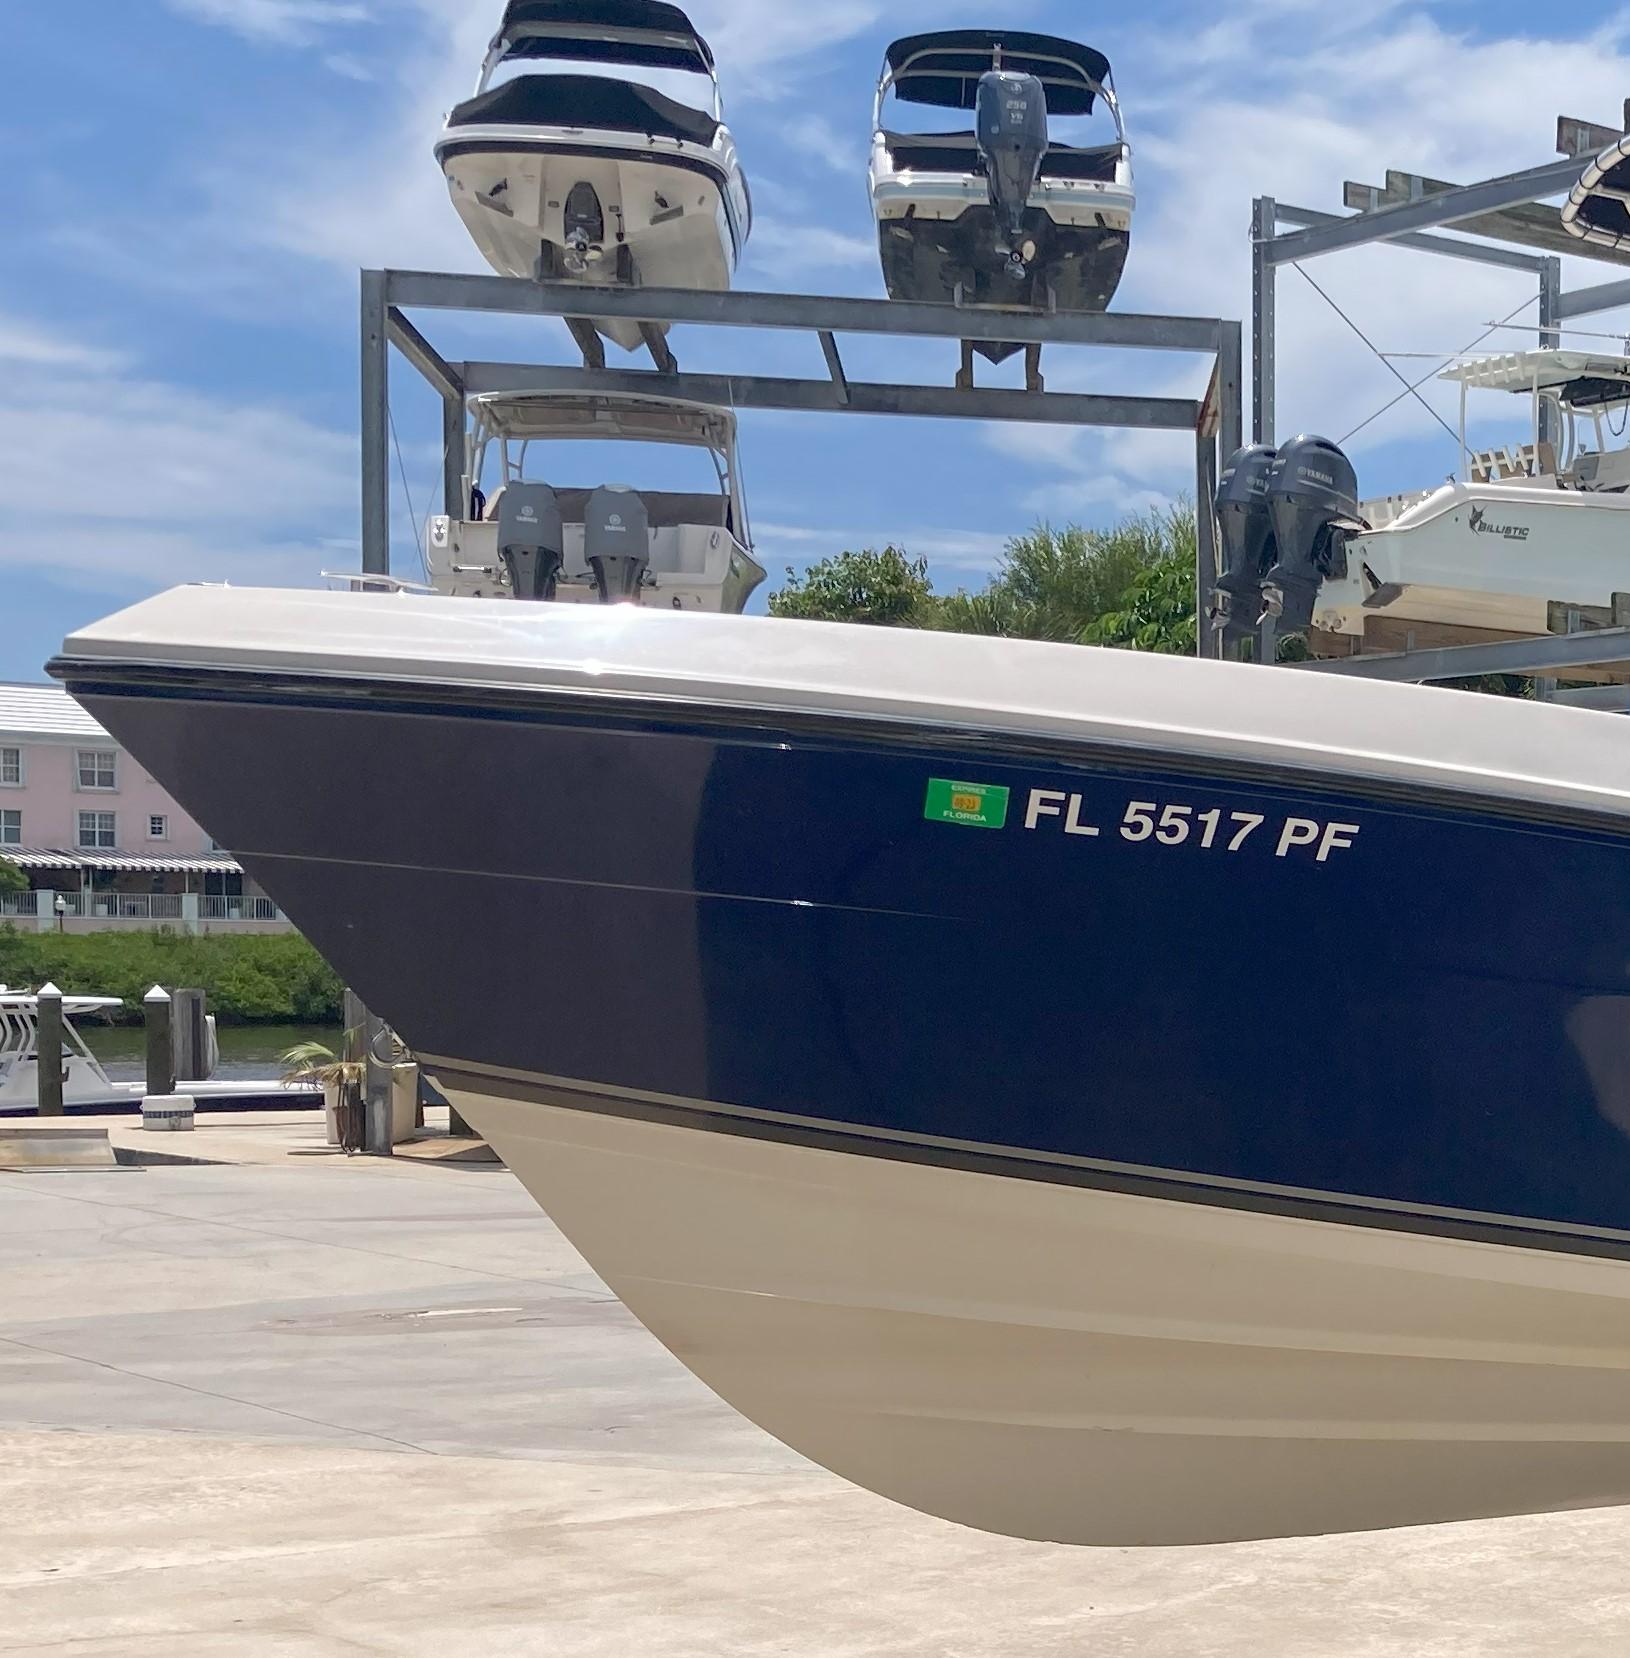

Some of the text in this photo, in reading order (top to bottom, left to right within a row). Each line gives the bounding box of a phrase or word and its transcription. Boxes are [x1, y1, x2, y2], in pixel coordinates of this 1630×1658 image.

[1307, 468, 1333, 485] YAMAHA
[943, 810, 987, 822] FLORIDA
[1025, 789, 1360, 862] FL 5517 PF
